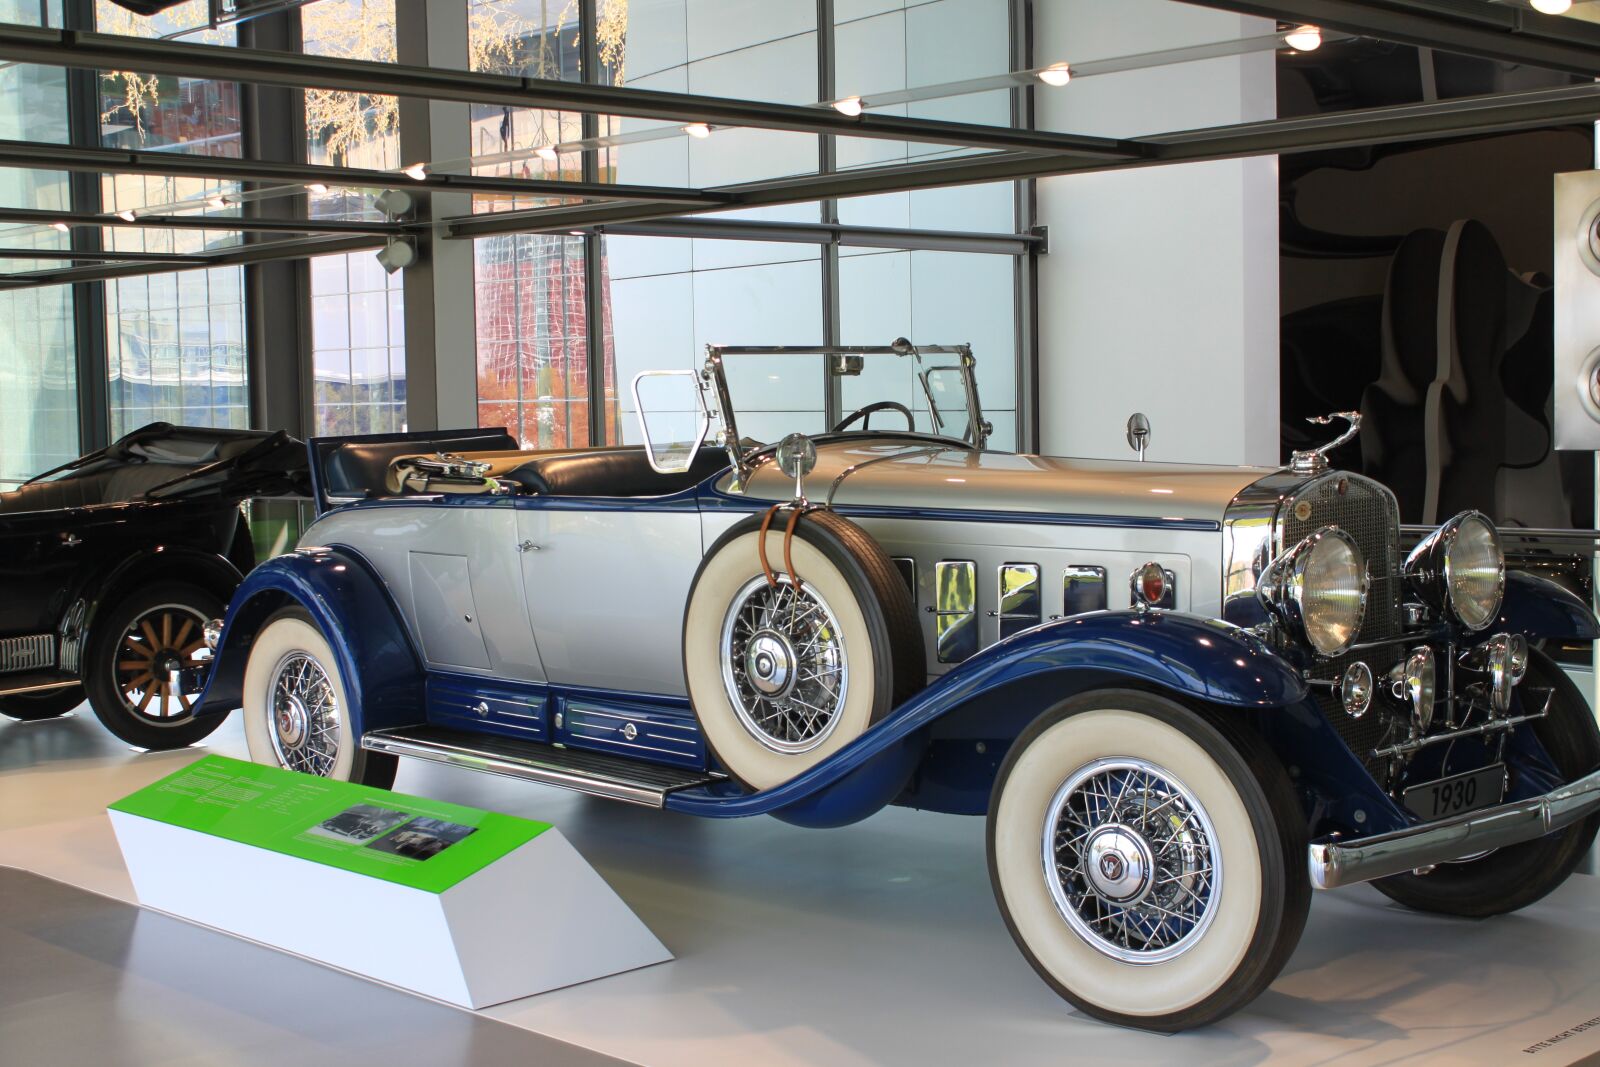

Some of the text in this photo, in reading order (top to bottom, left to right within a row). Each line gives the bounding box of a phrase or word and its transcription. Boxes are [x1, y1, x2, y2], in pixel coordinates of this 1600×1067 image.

[1431, 777, 1477, 816] 1930
[1522, 1041, 1552, 1054] BITTE
[1545, 1030, 1576, 1044] NICHT
